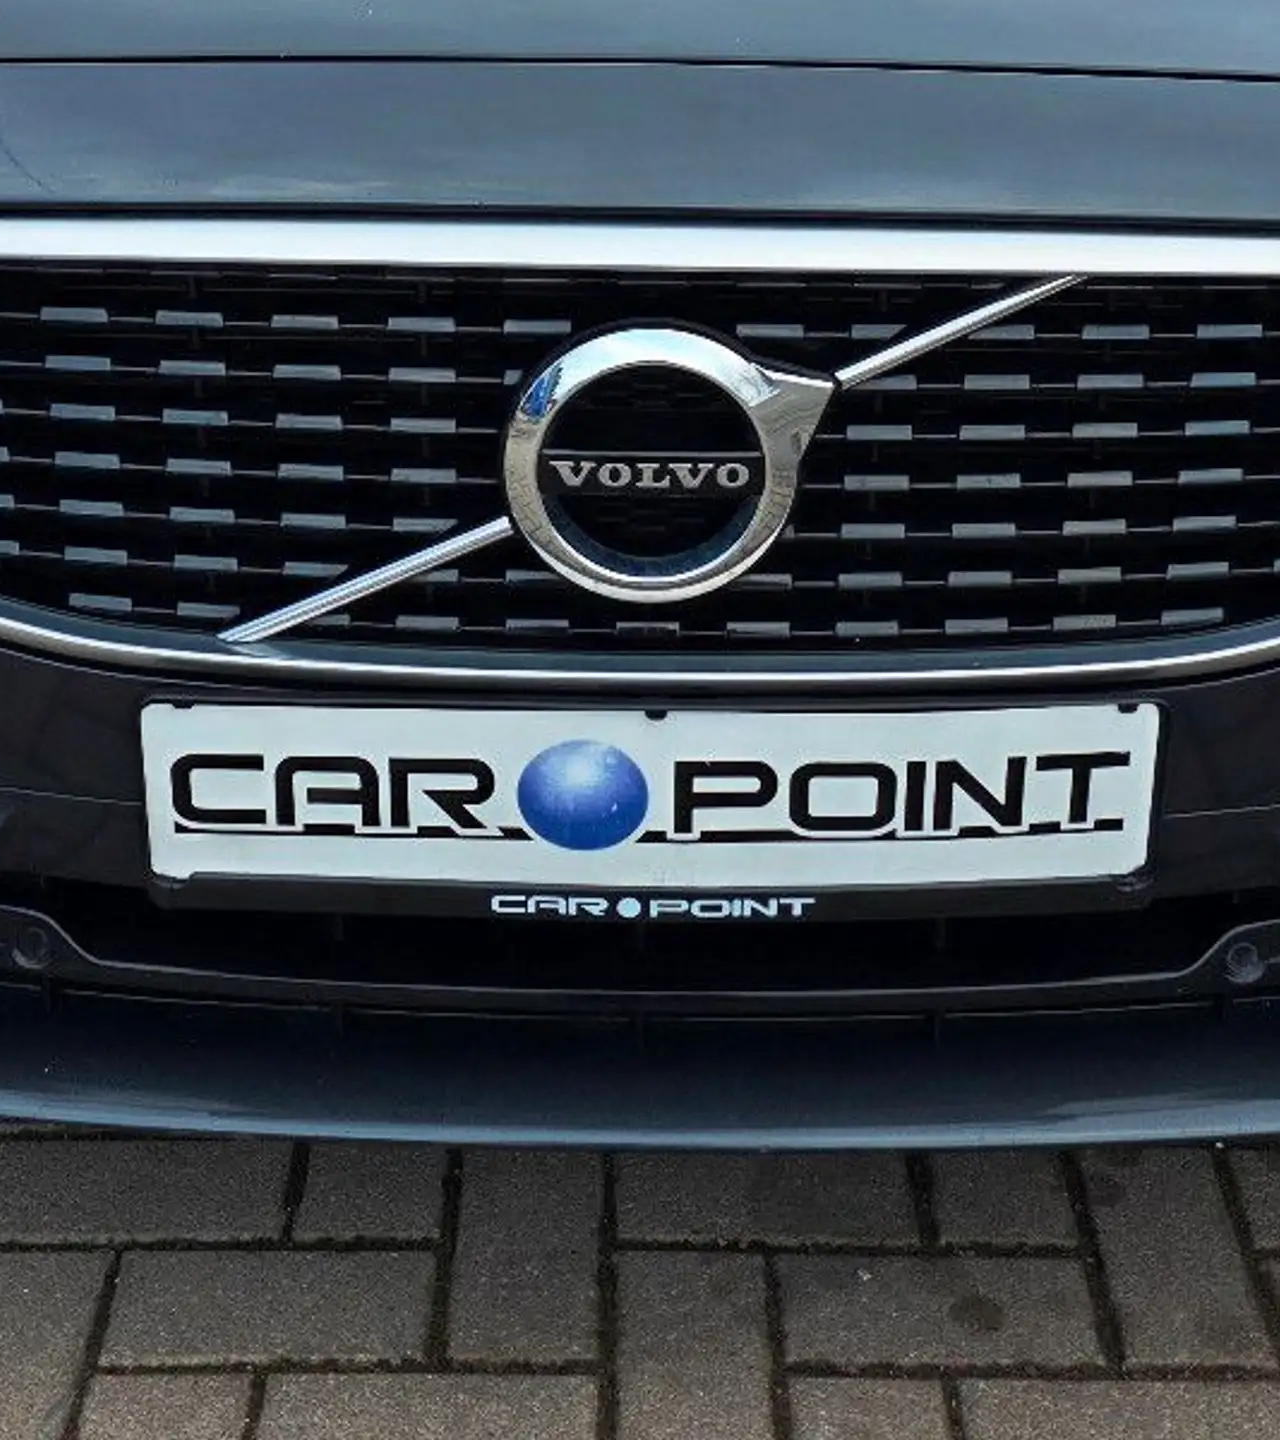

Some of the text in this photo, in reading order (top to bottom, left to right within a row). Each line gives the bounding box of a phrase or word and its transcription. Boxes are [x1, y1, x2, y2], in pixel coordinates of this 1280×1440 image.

[549, 460, 750, 489] VOLVO
[170, 750, 1131, 839] CAR POINT
[491, 895, 816, 918] CAR POINT
